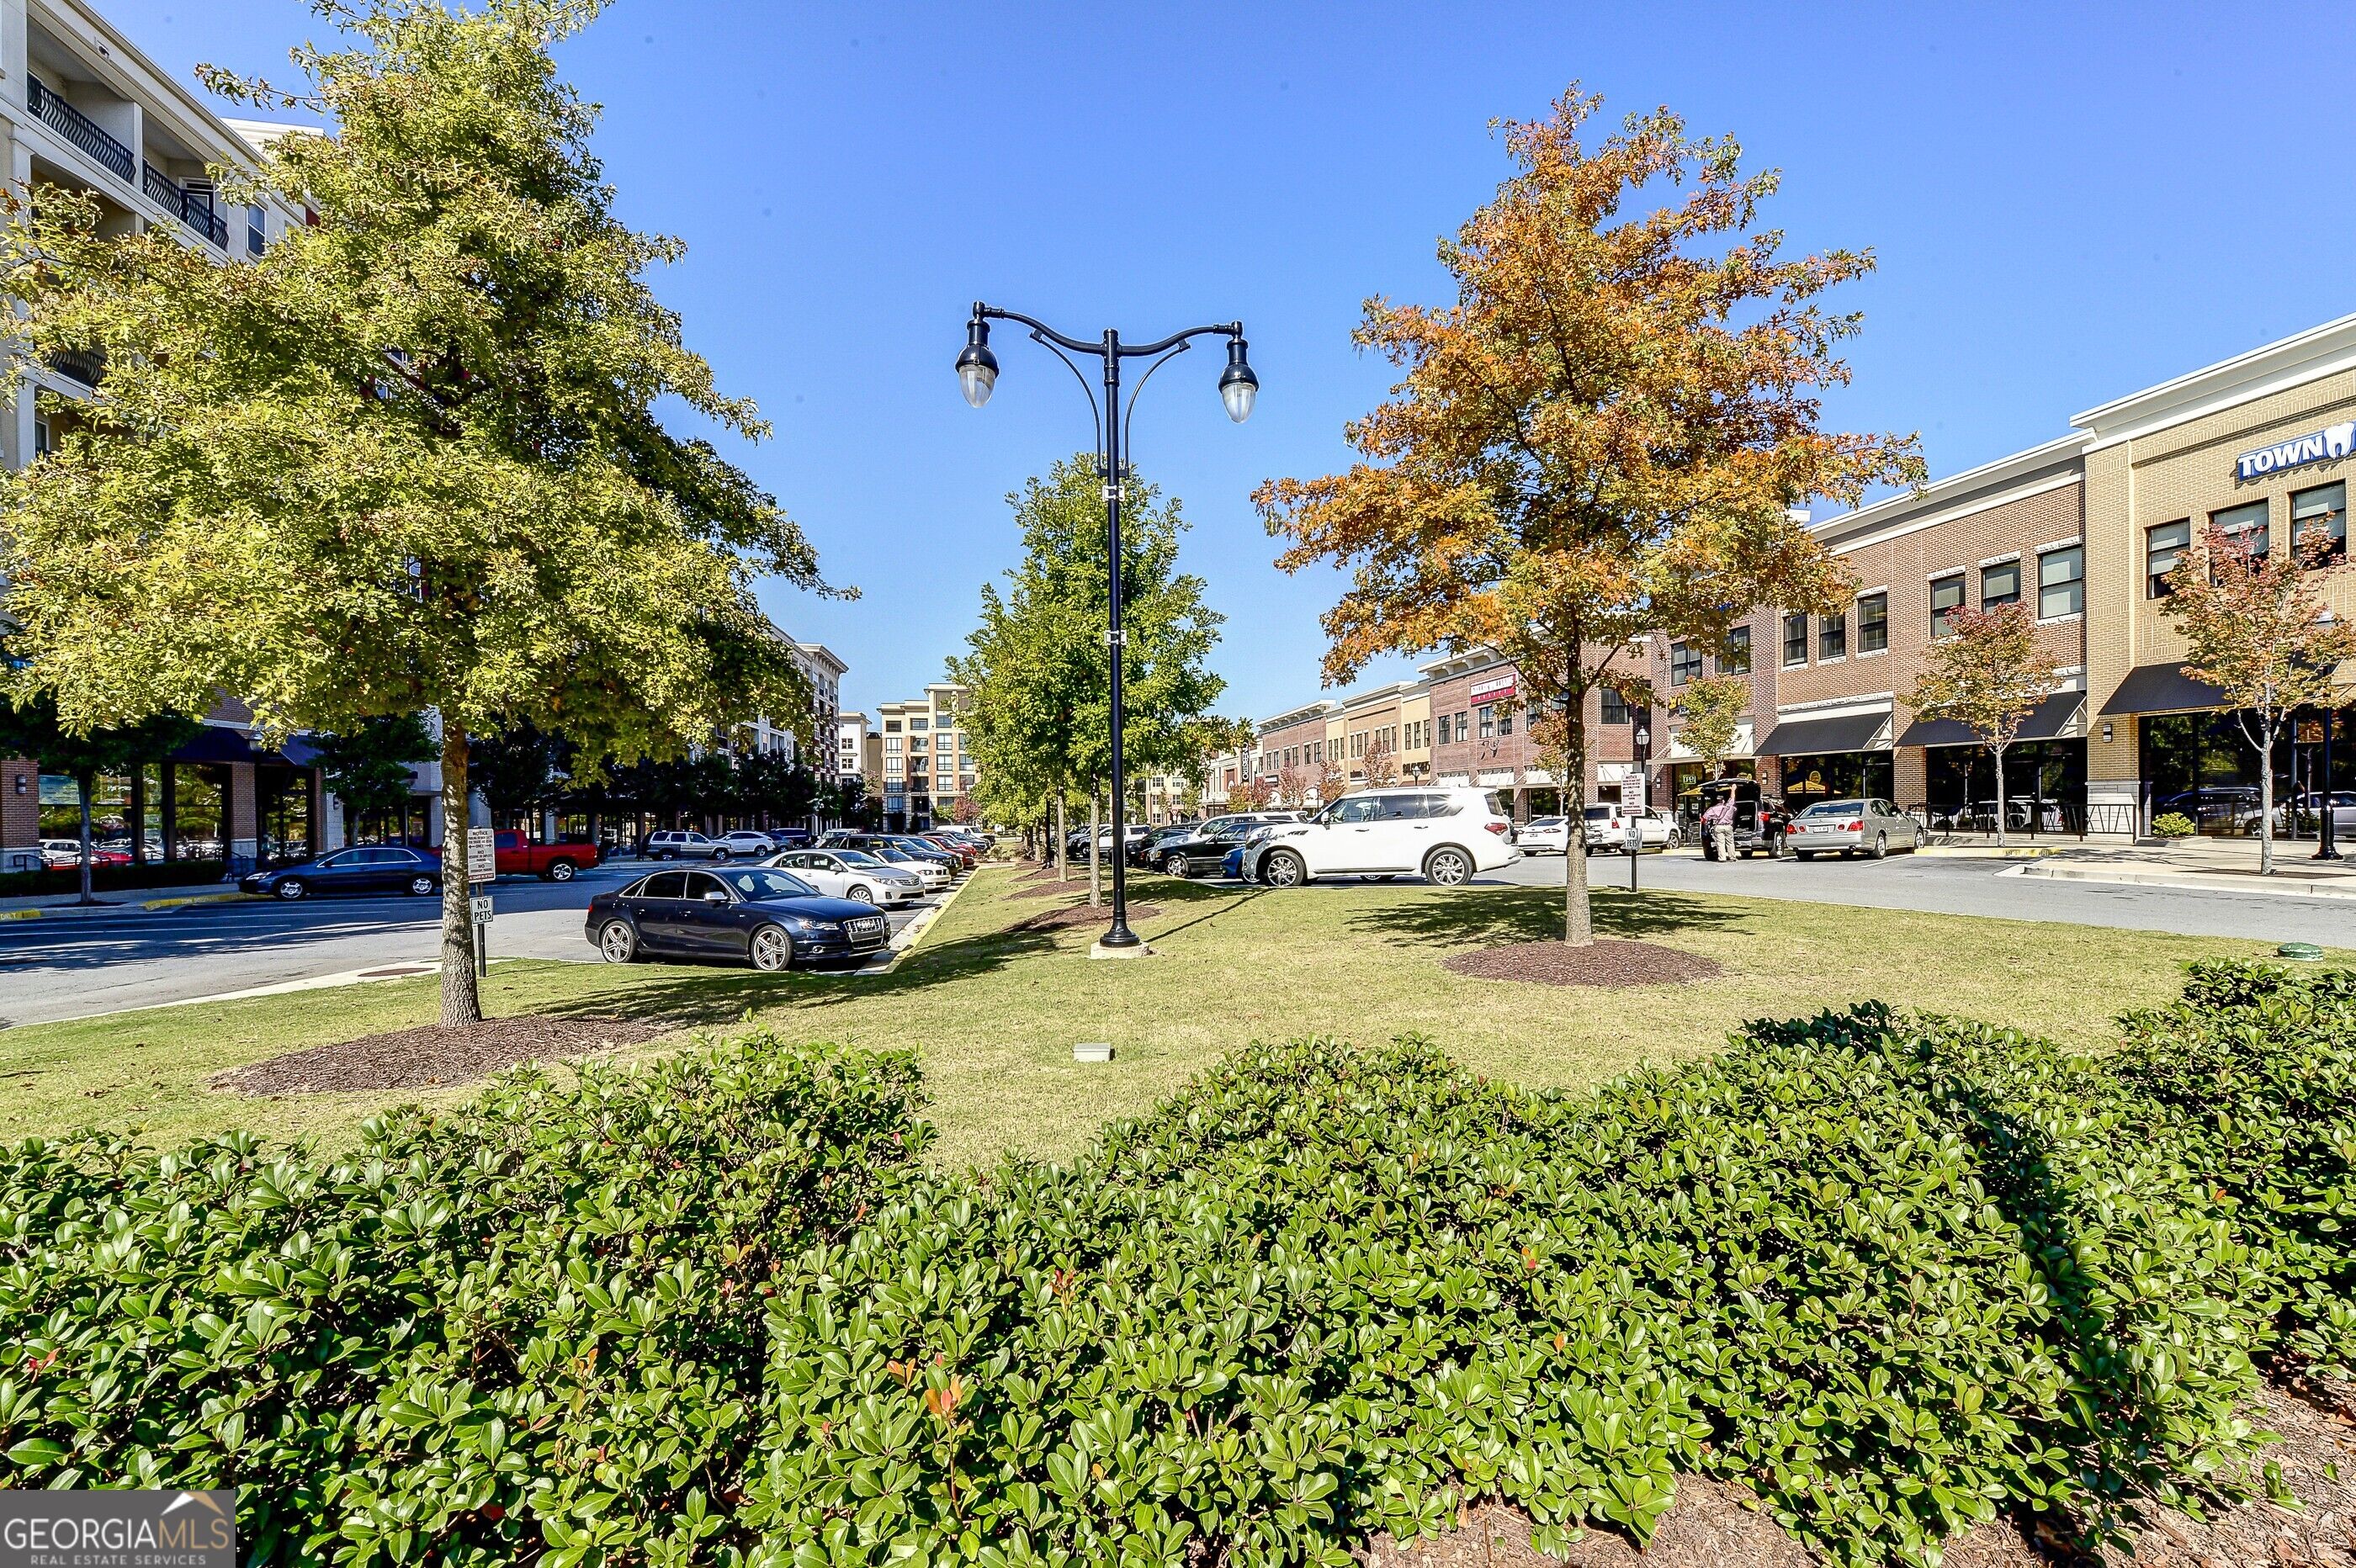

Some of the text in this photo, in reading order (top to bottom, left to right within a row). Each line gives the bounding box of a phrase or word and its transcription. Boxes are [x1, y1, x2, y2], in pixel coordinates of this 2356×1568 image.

[2238, 435, 2323, 477] TOWN
[477, 899, 488, 909] NO
[474, 910, 491, 921] PETS
